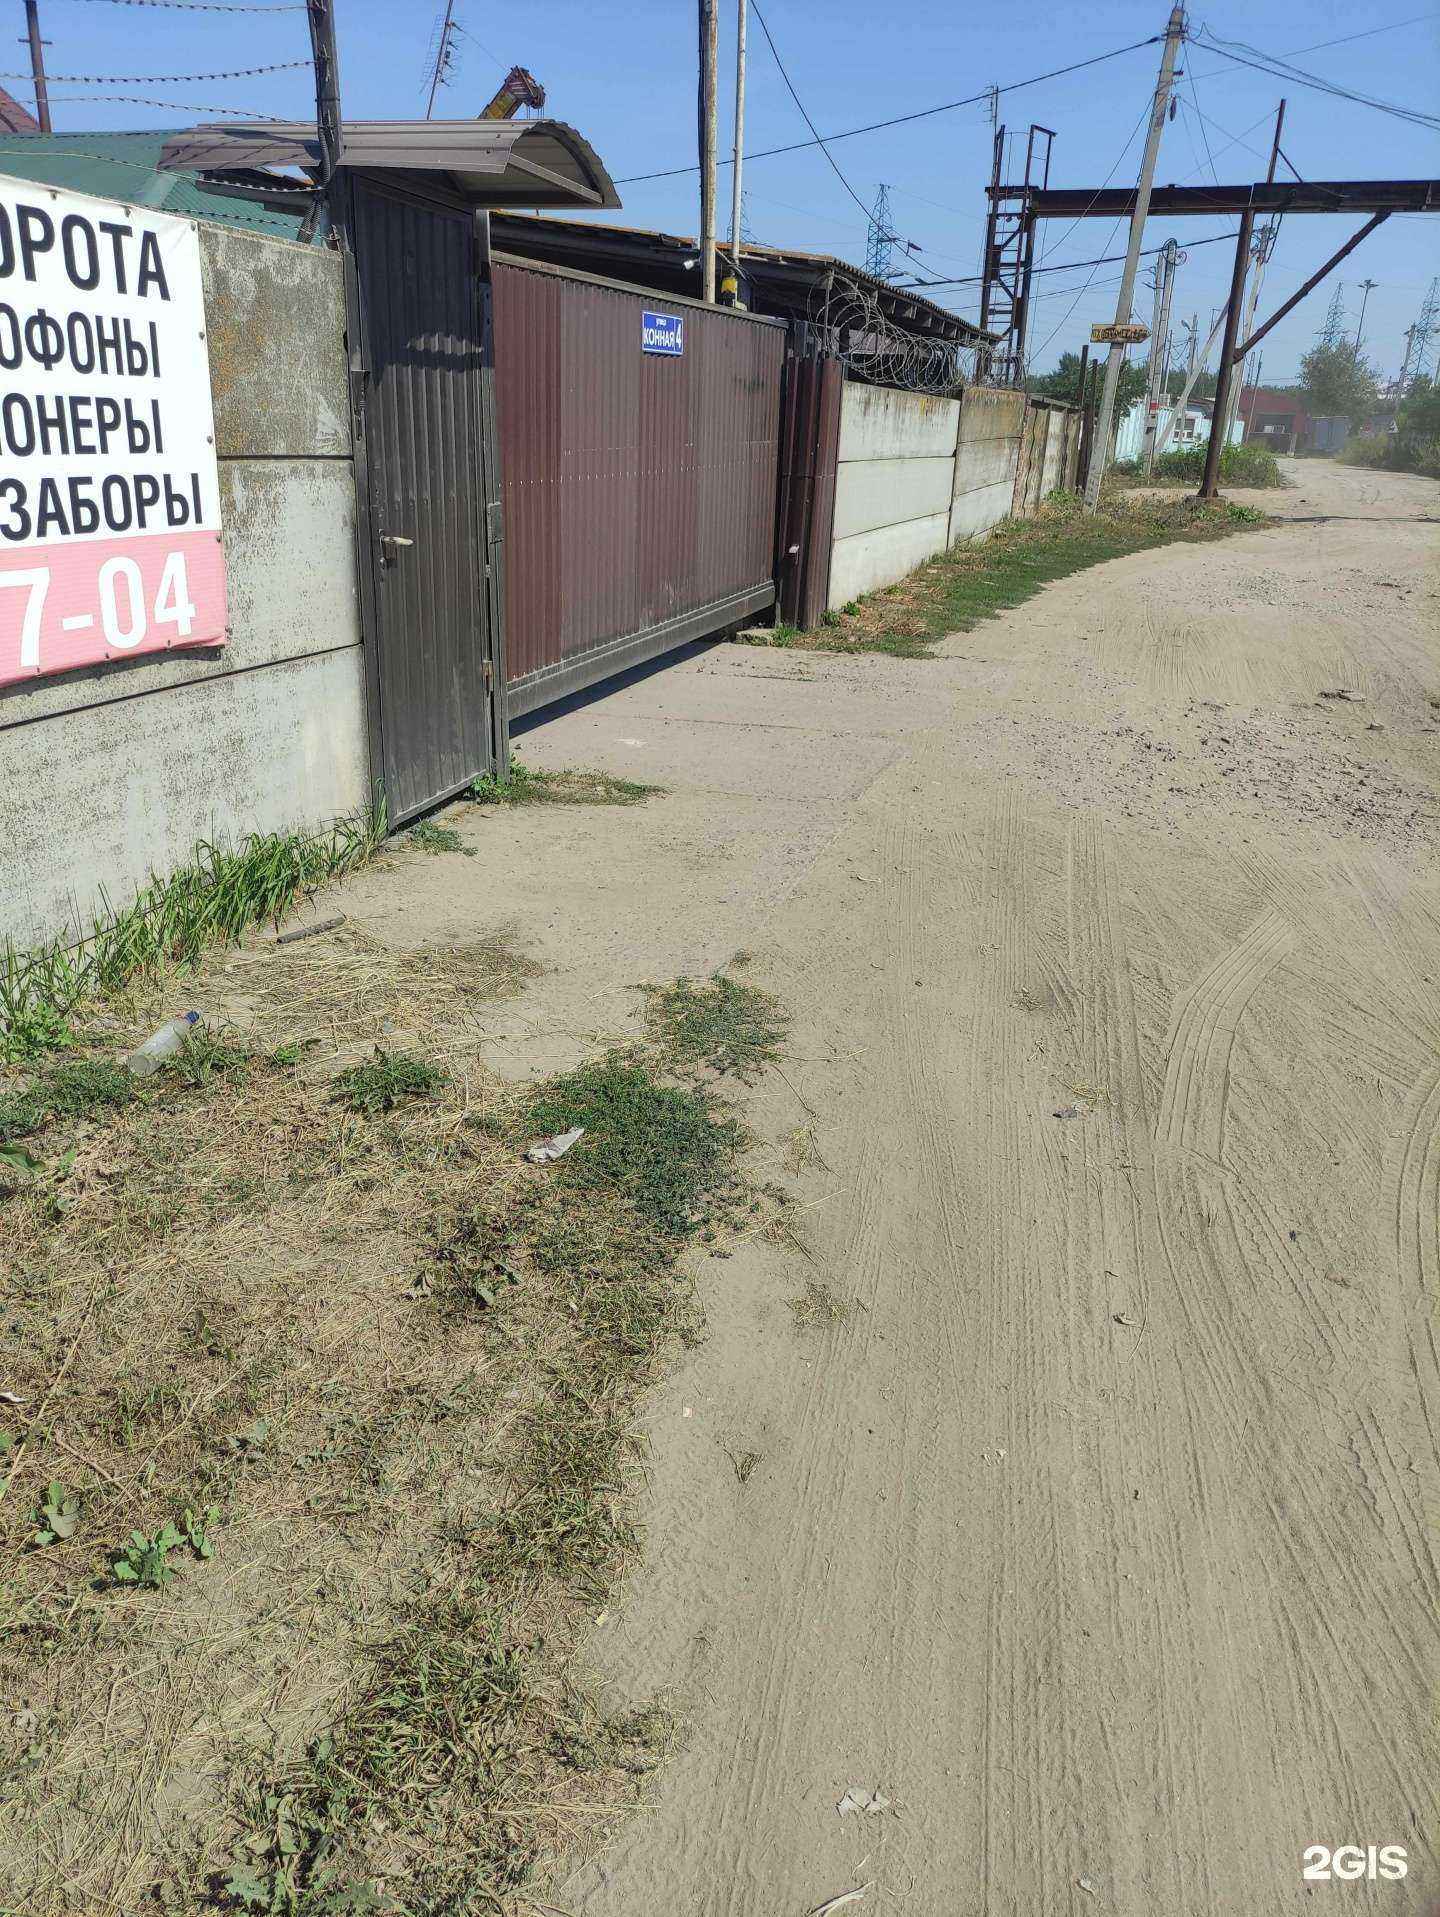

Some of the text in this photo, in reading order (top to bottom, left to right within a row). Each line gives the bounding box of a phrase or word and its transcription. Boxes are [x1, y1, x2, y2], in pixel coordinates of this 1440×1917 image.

[0, 303, 161, 378] ОФОНЫ
[643, 324, 682, 349] КОННАЯ 4
[0, 393, 163, 457] ОНЕРЫ
[0, 473, 203, 541] ЗАБОРЫ
[0, 551, 196, 667] 7-04
